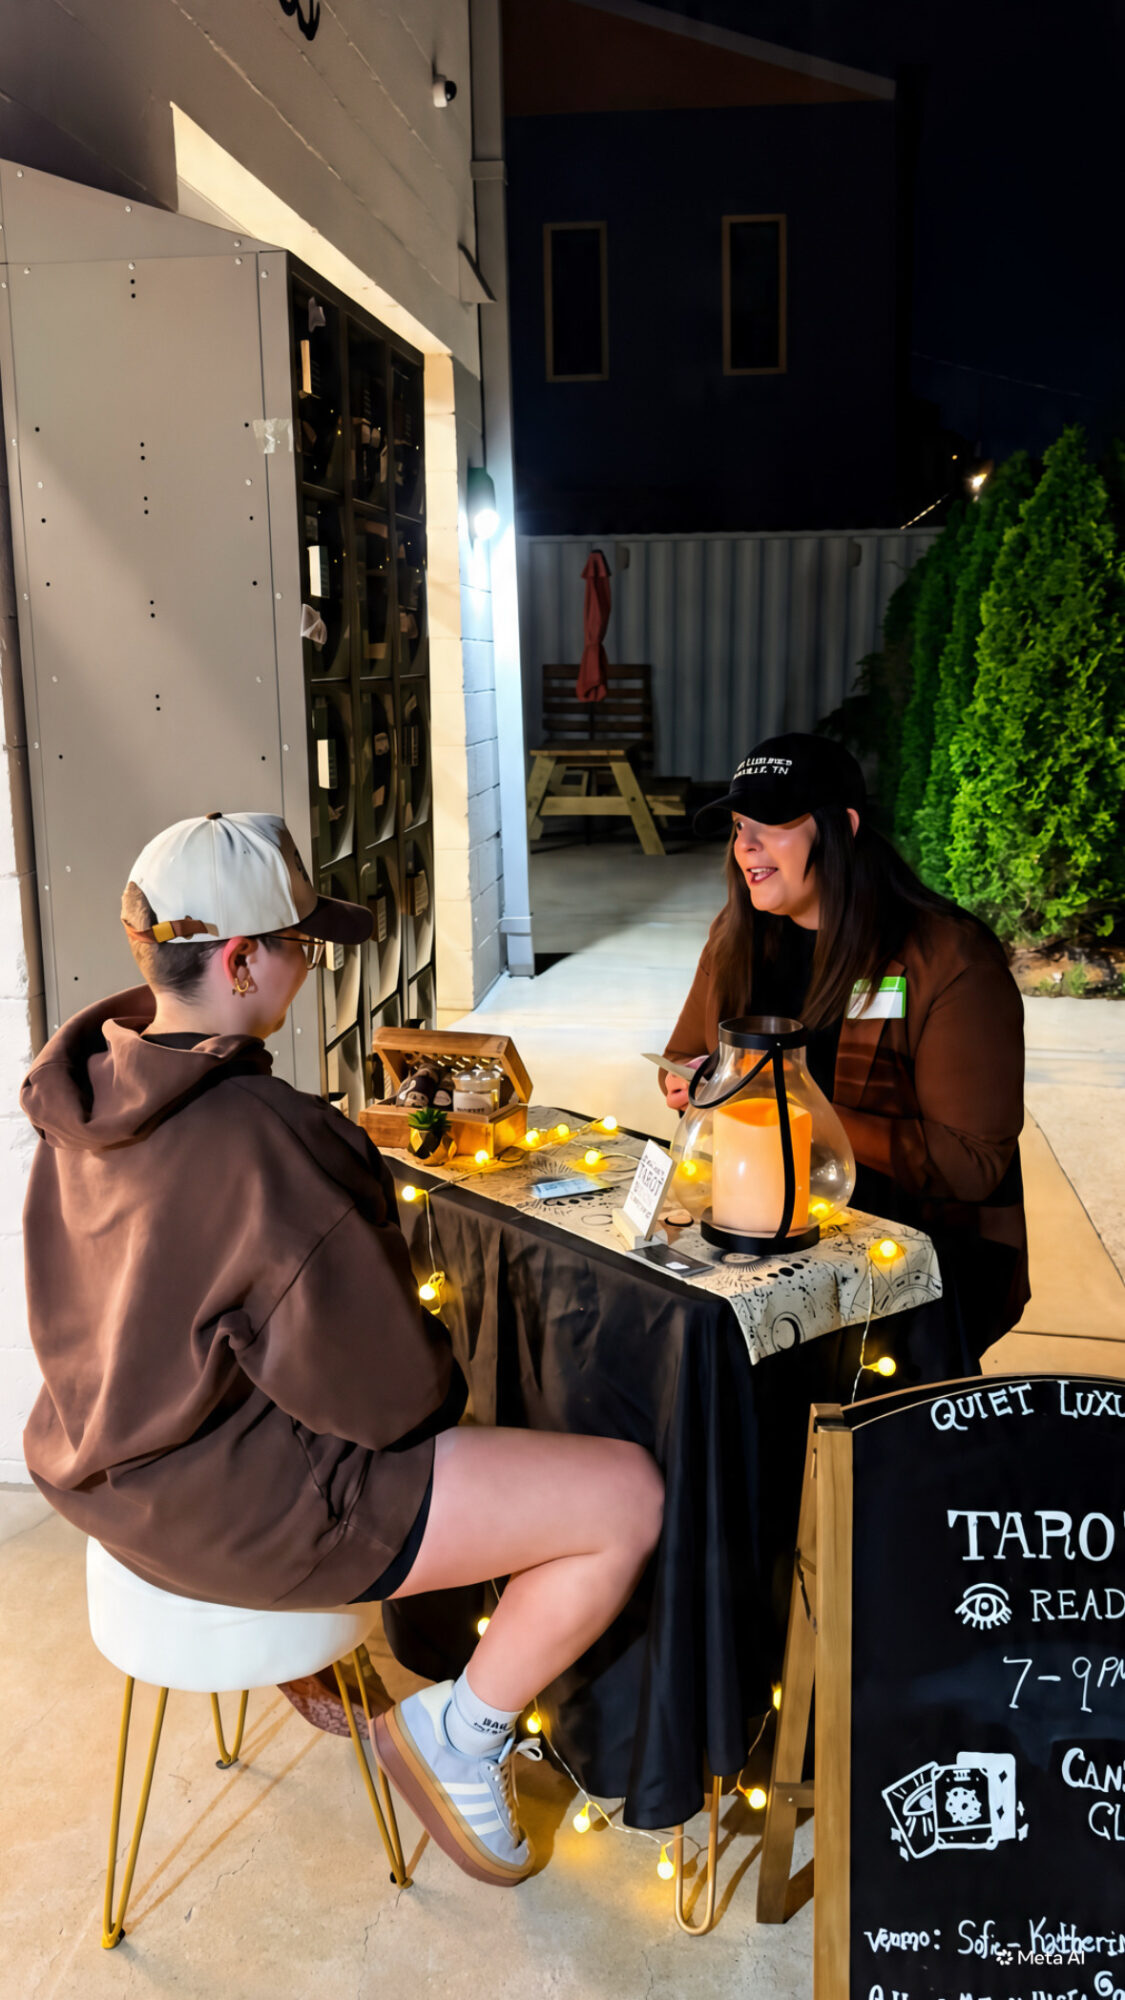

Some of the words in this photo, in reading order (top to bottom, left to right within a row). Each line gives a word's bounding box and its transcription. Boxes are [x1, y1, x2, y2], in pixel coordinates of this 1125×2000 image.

[772, 766, 790, 775] TN
[930, 1382, 1034, 1431] QUIET
[947, 1509, 1125, 1562] TARO
[1029, 1588, 1125, 1622] READ
[1061, 1747, 1125, 1793] CAN
